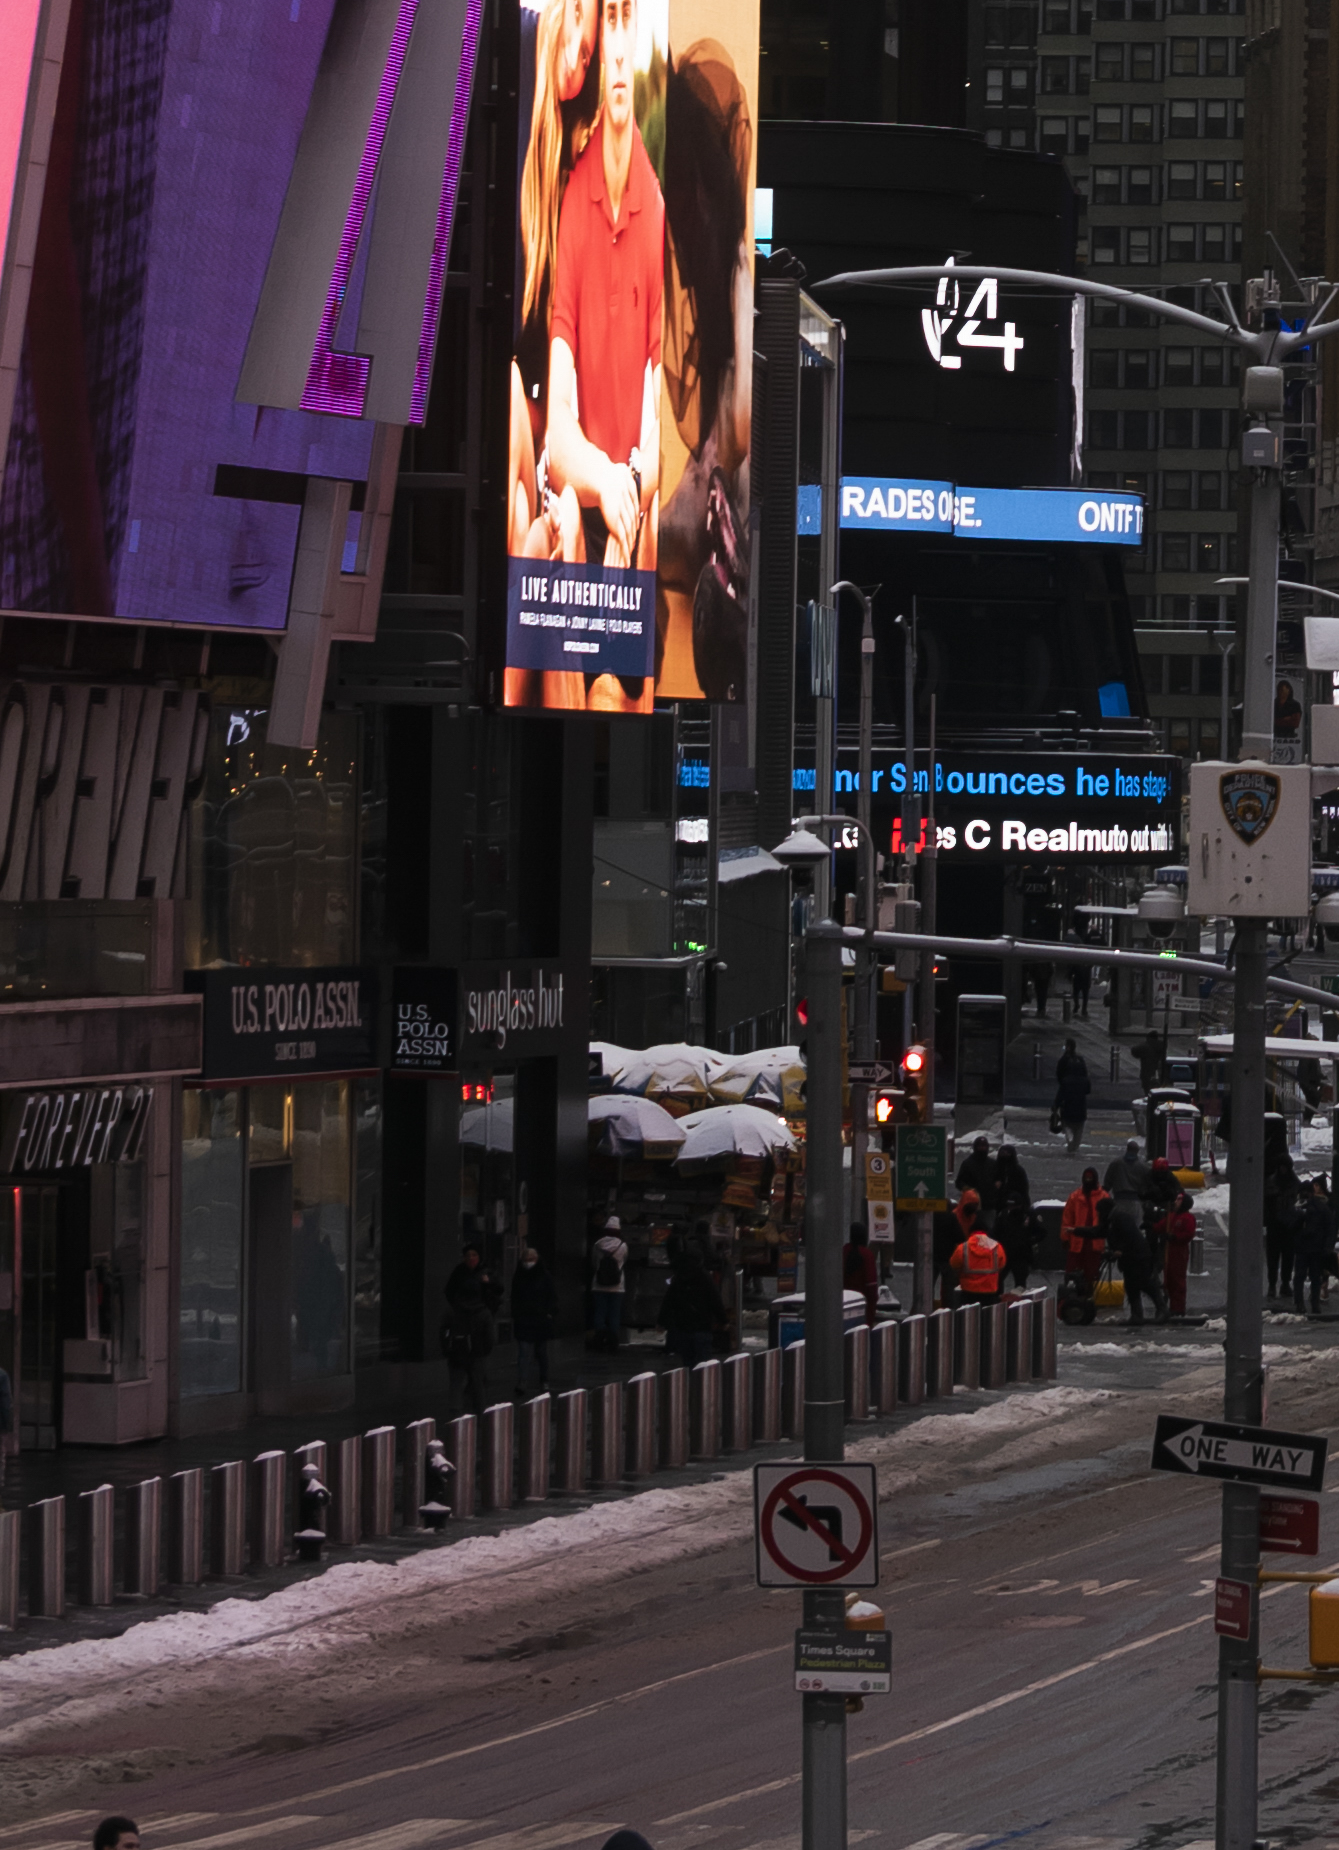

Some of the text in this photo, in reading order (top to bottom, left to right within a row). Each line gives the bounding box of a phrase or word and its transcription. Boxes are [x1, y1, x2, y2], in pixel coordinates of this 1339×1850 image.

[521, 575, 643, 611] LIVE AUTHENTICALLY
[1076, 766, 1140, 798] he has
[964, 819, 991, 850] C
[1002, 820, 1127, 852] Realmuto
[1131, 828, 1150, 852] out
[1024, 881, 1048, 893] ZEN
[1322, 978, 1333, 992] W
[230, 979, 363, 1034] U.S. POLO ASSN.
[397, 1003, 432, 1021] U.S.
[467, 968, 564, 1050] sunglass hut
[396, 1020, 449, 1039] POLO
[396, 1038, 453, 1057] ASSN.
[10, 1090, 121, 1172] FOREVER
[907, 1165, 936, 1178] South
[1180, 1438, 1304, 1473] ONE WAY
[799, 1643, 876, 1660] Times Square
[799, 1656, 887, 1670] Pedestrian Plaza
